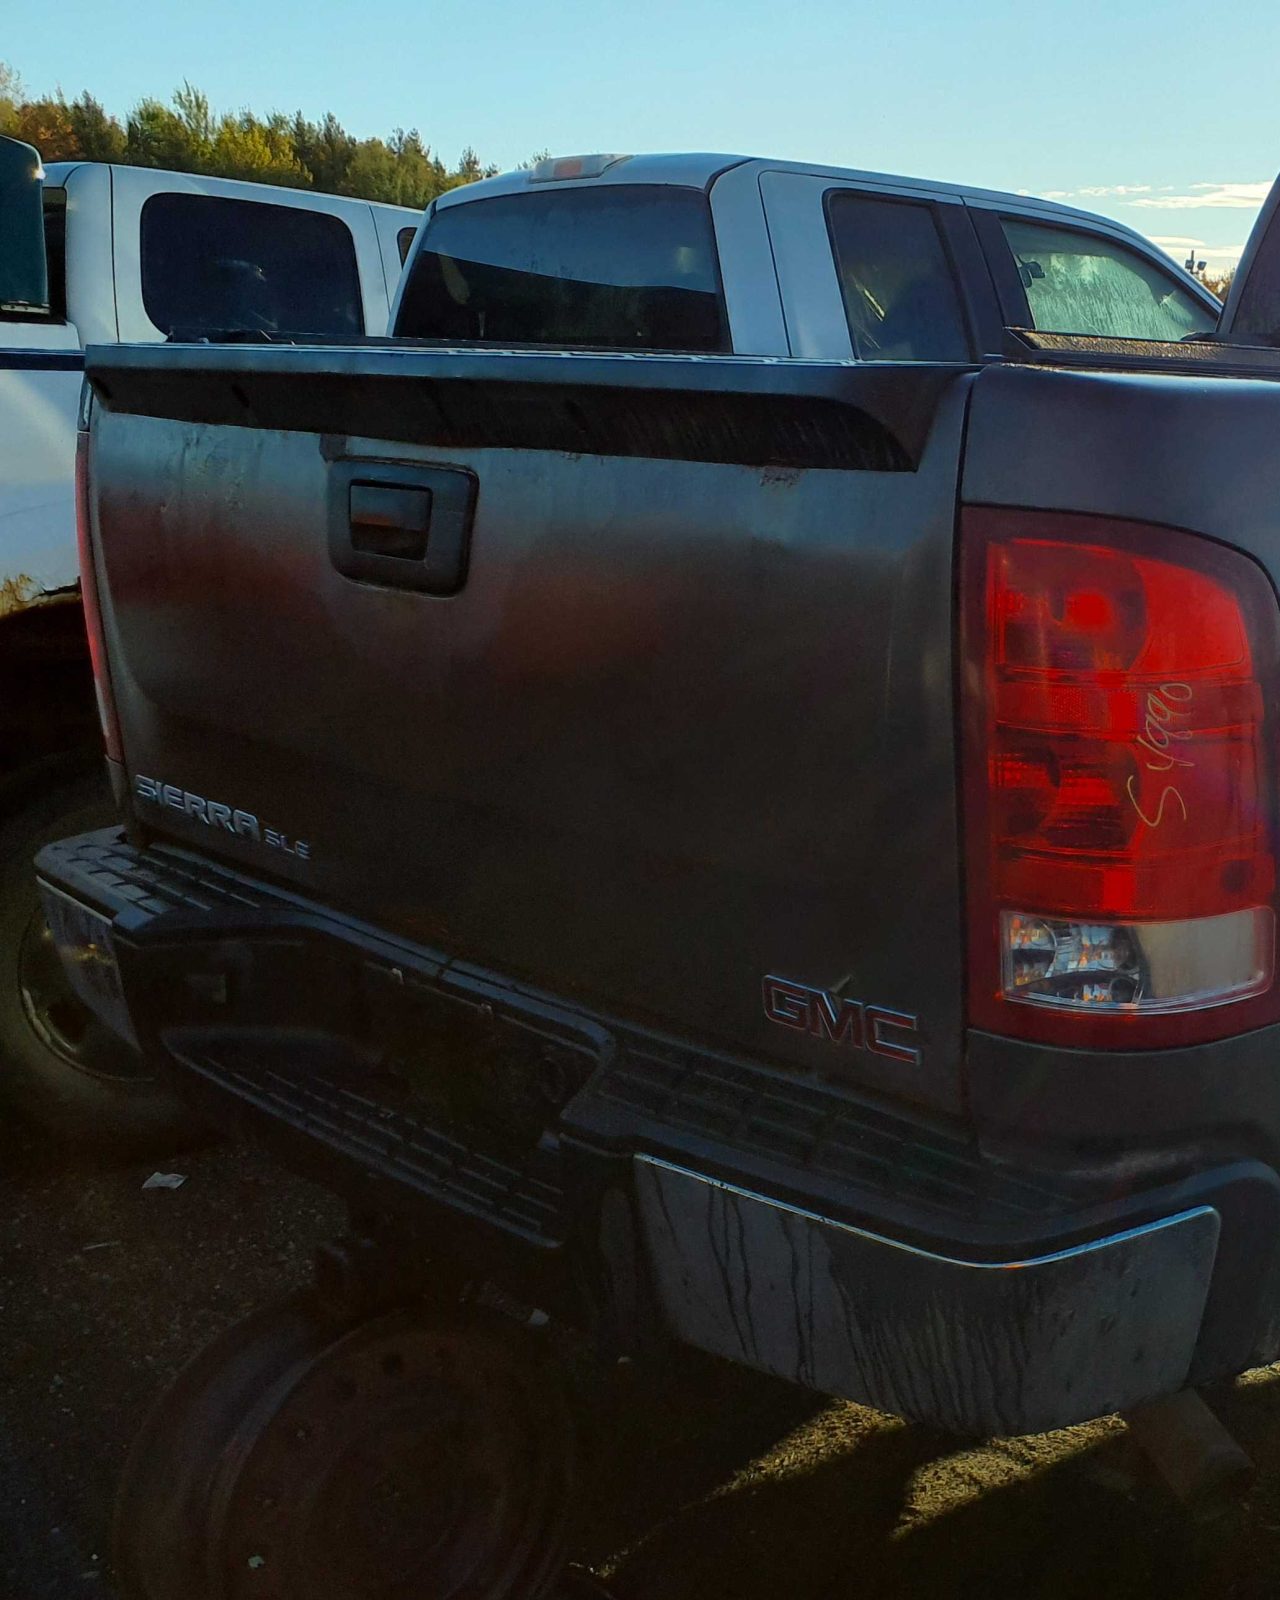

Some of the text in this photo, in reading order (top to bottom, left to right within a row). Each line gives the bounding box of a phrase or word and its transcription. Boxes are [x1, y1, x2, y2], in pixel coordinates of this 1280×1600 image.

[135, 774, 311, 860] SIERRA SLE
[762, 974, 921, 1067] GMC
